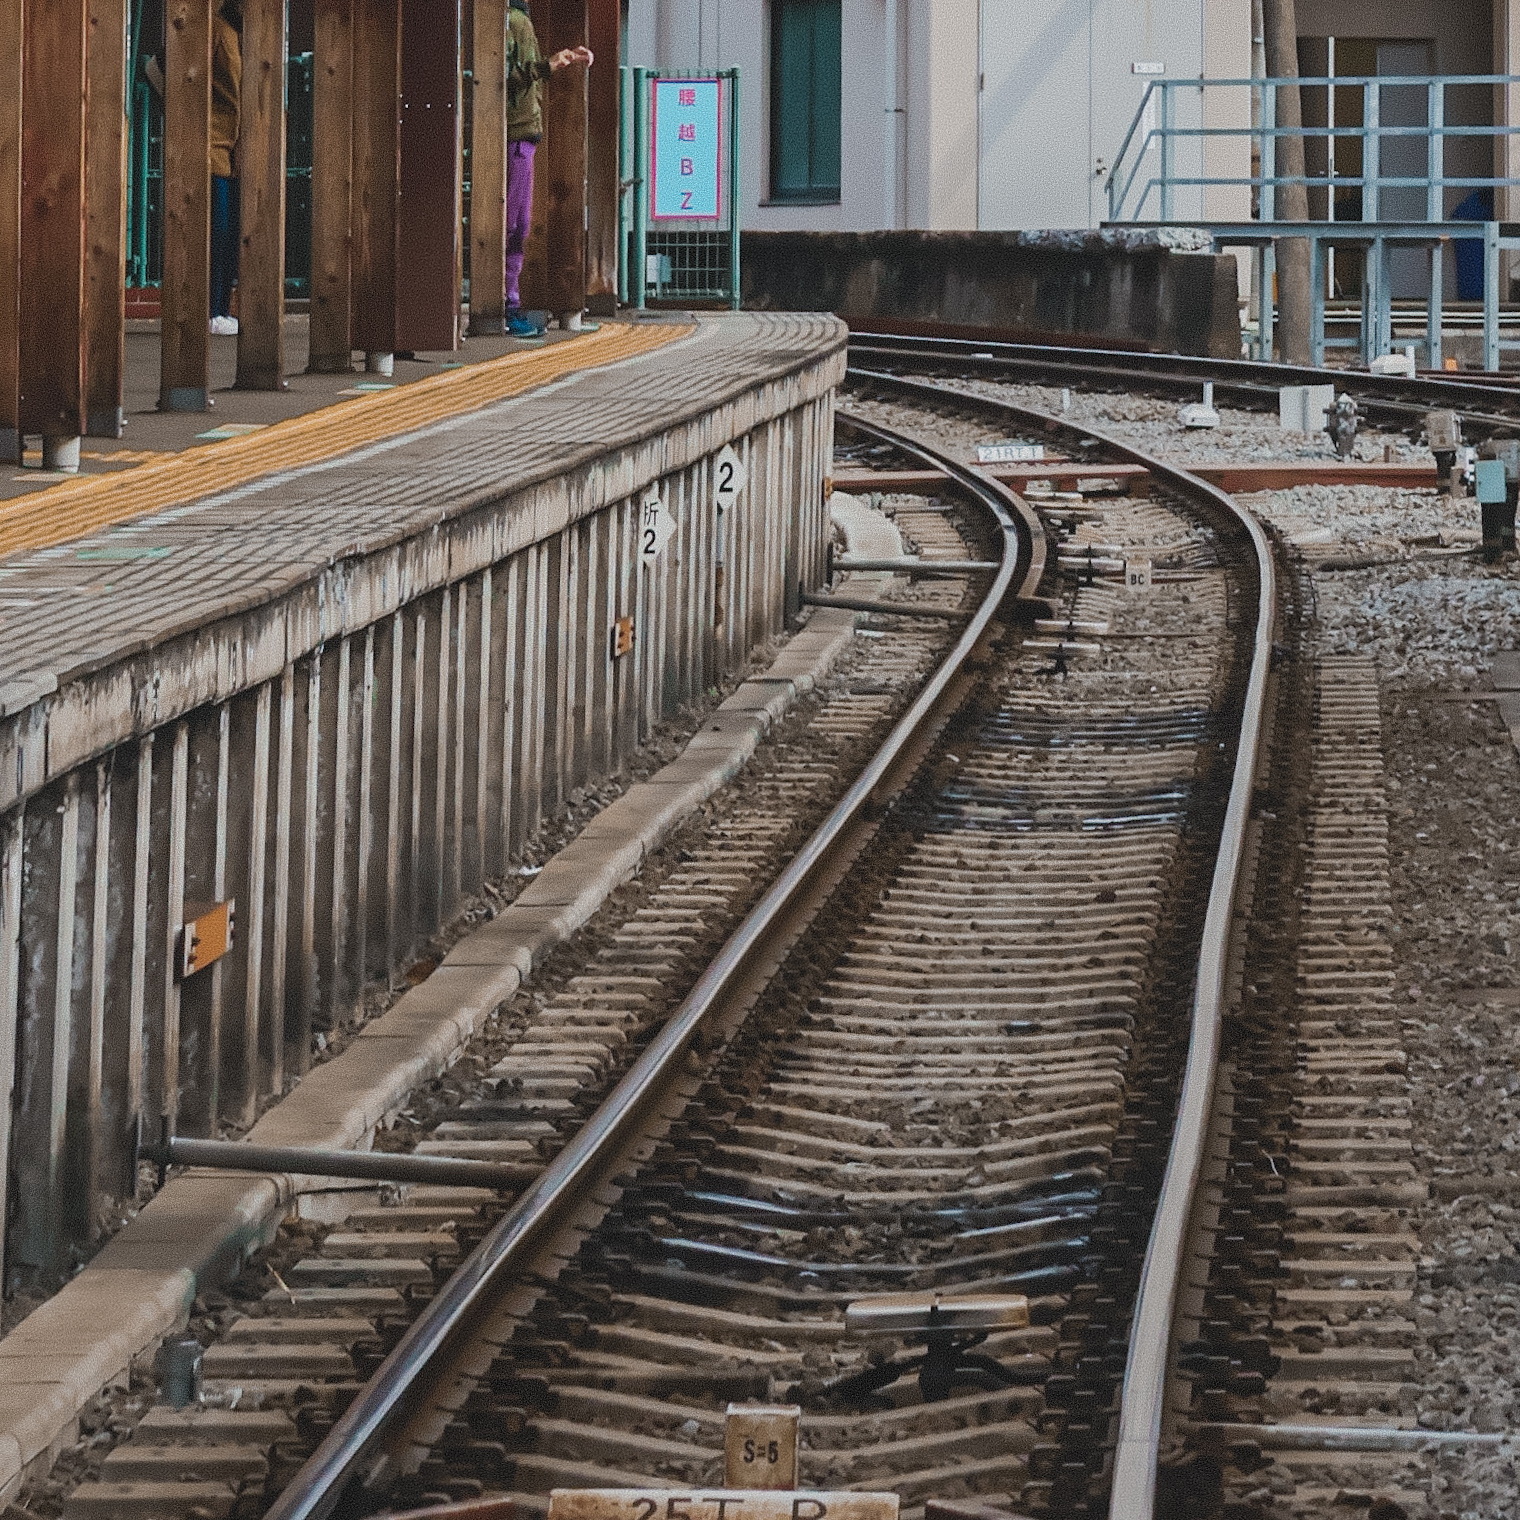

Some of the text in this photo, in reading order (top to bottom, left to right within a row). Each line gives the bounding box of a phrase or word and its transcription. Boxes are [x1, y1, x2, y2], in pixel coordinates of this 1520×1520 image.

[719, 461, 734, 493] 2
[643, 528, 656, 554] 2
[1130, 573, 1145, 586] BC
